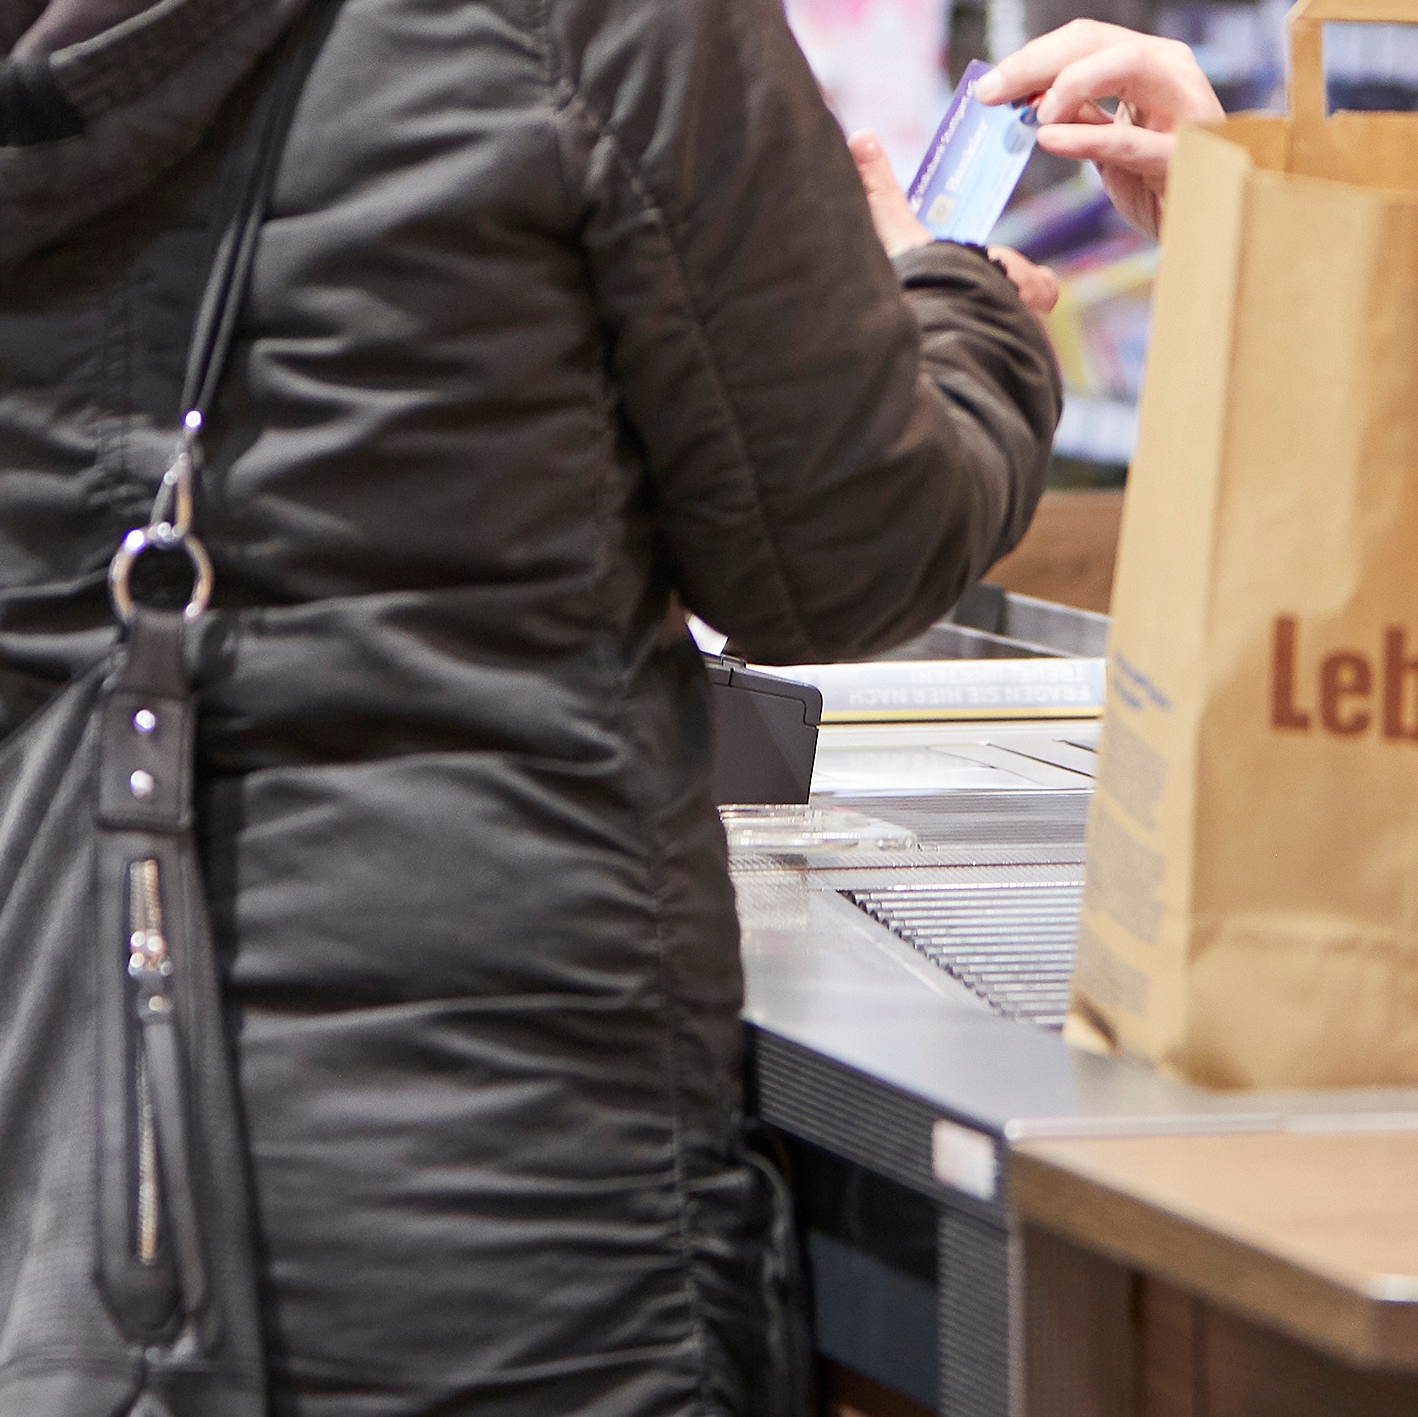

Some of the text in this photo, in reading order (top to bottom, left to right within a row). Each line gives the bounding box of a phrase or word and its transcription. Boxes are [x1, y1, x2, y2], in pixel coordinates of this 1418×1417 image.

[849, 684, 1090, 707] FRAGEN SIE HIER NACH
